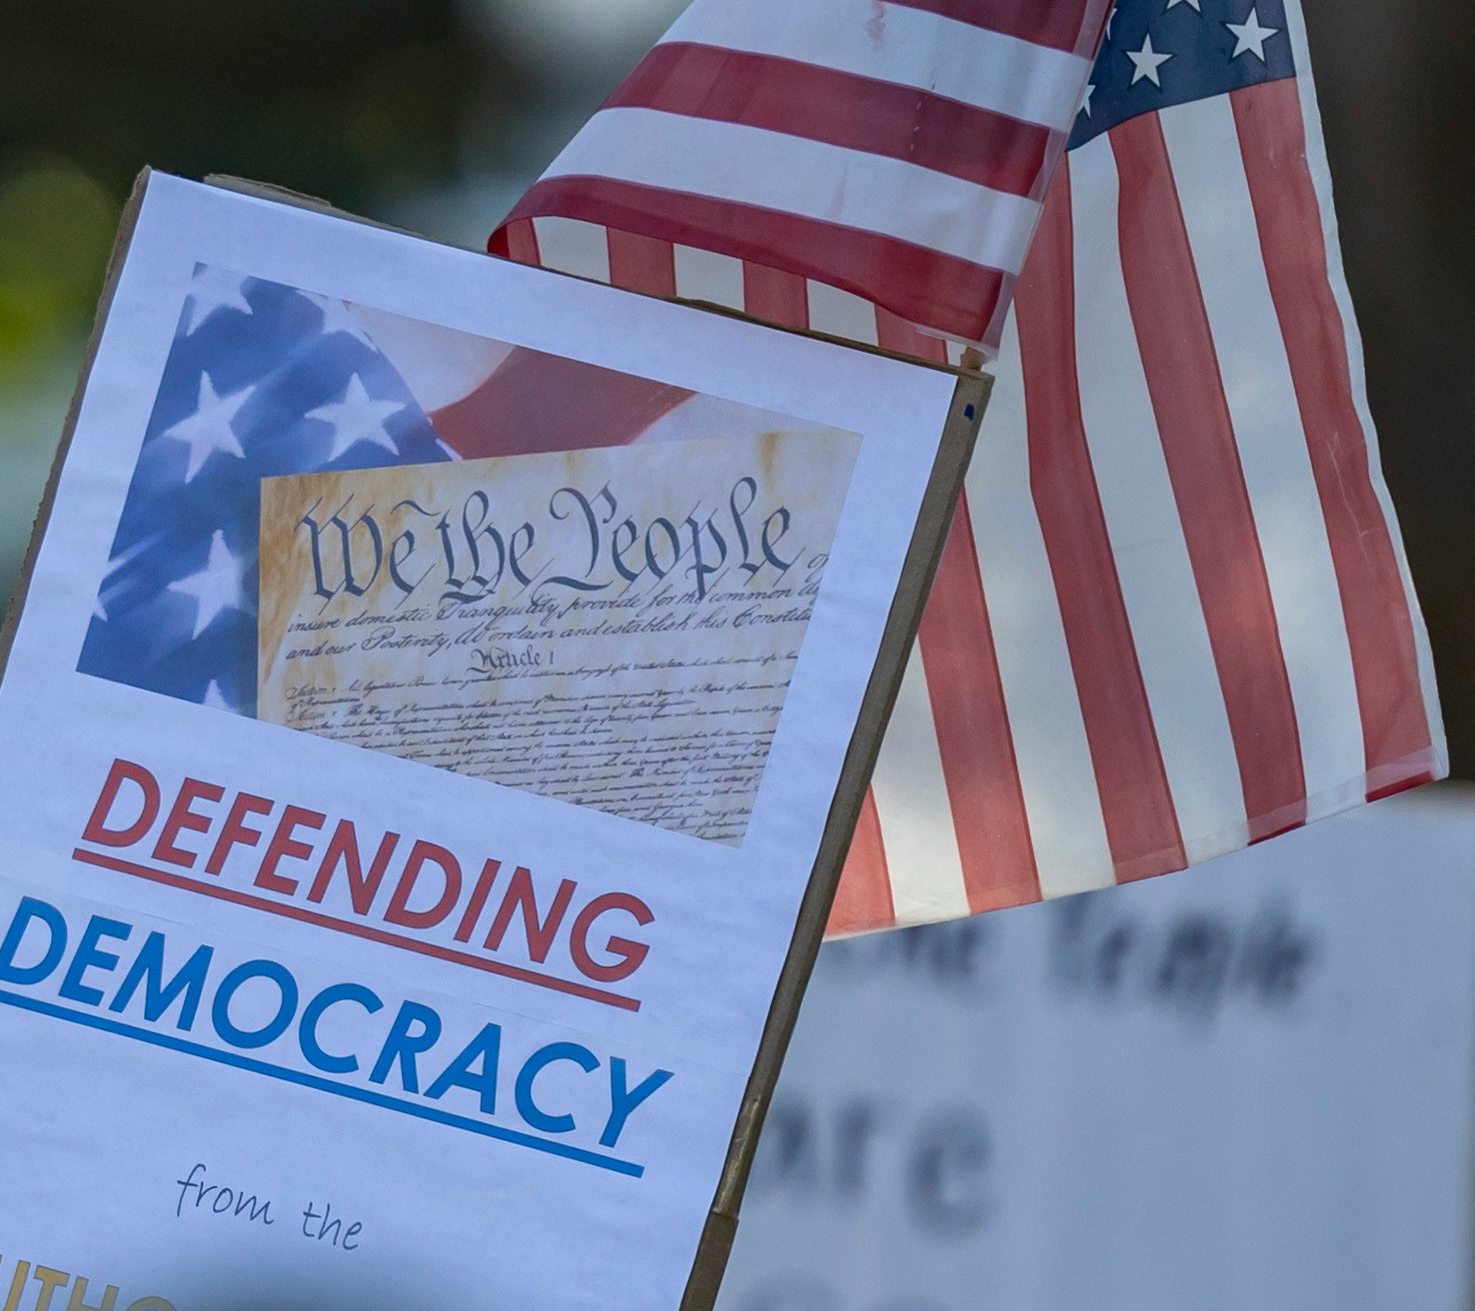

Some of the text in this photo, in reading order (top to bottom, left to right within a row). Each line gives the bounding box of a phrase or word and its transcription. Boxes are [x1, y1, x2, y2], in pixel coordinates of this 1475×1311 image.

[294, 476, 806, 616] We the People
[286, 640, 324, 660] and
[324, 641, 356, 657] our
[488, 625, 553, 641] ordain
[560, 619, 606, 638] and
[603, 612, 694, 635] establish
[287, 614, 341, 632] insure
[346, 603, 432, 626] domestic
[558, 593, 642, 619] provide
[636, 583, 677, 617] for
[708, 585, 792, 604] common
[466, 644, 540, 673] Article
[80, 758, 656, 983] DEFENDING
[176, 1163, 363, 1250] from the
[758, 1085, 999, 1244] are
